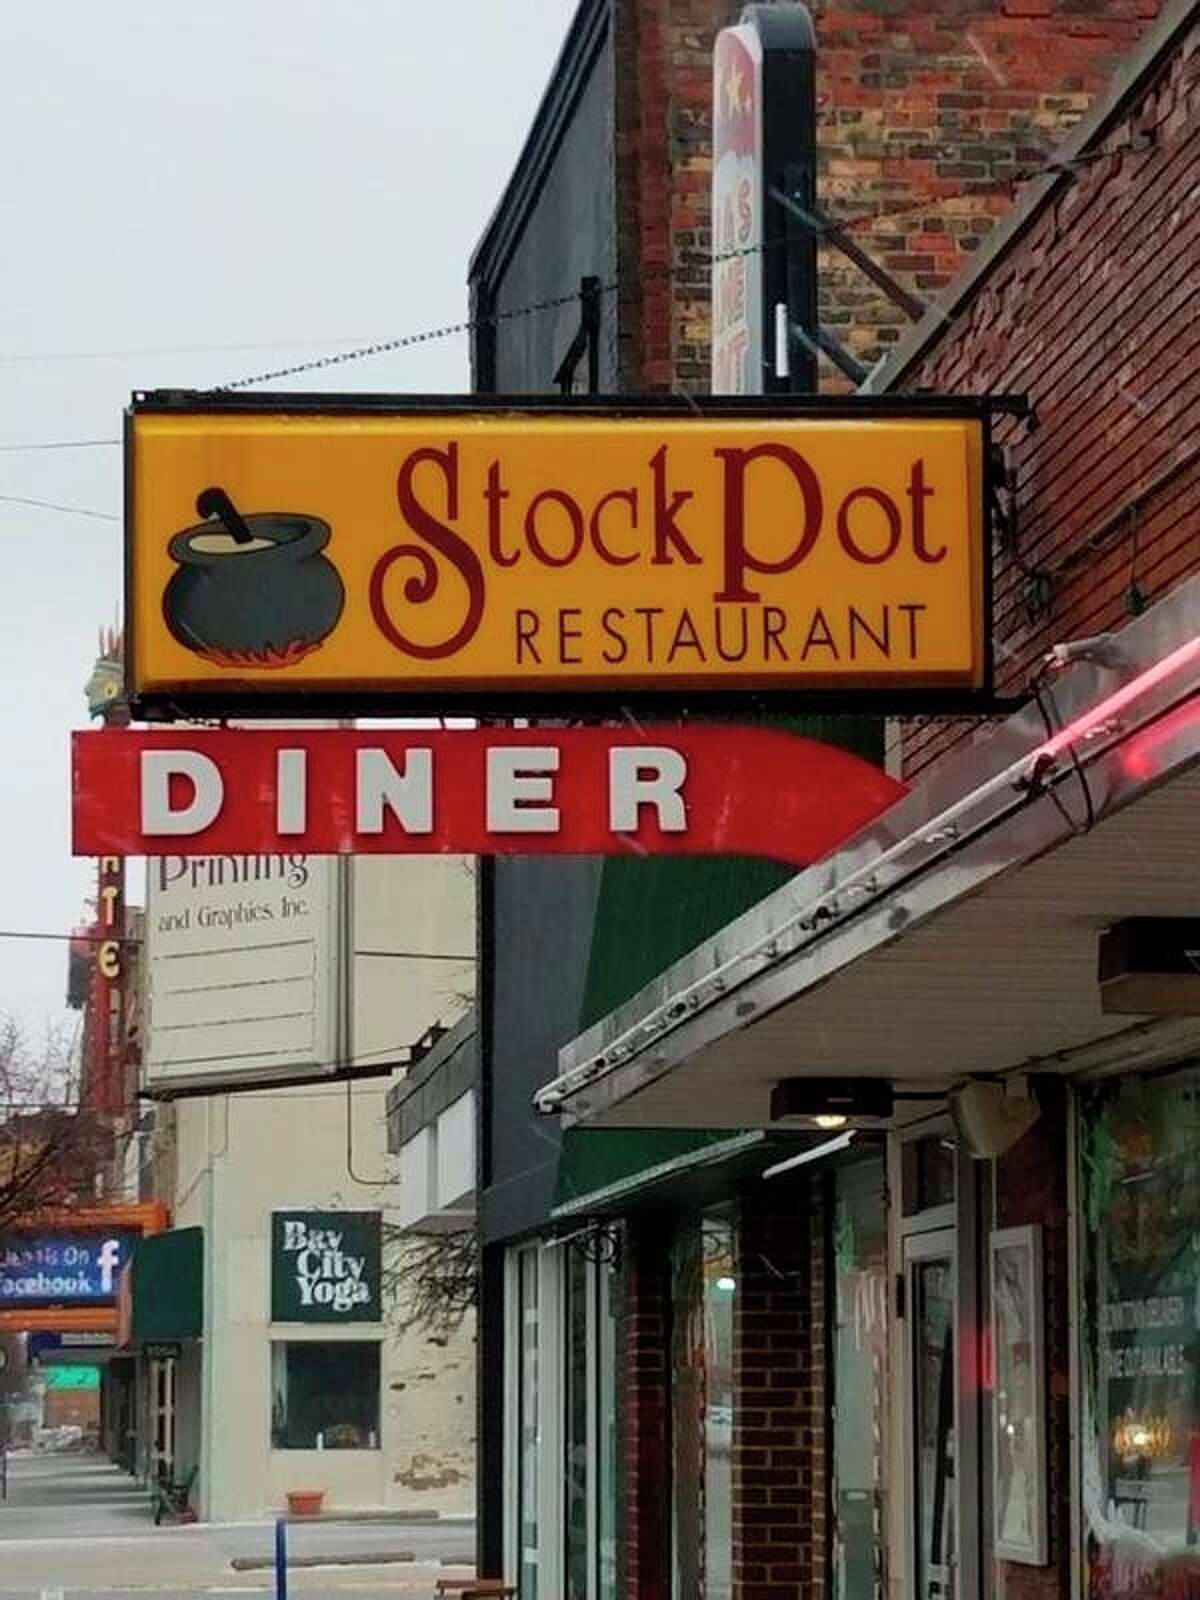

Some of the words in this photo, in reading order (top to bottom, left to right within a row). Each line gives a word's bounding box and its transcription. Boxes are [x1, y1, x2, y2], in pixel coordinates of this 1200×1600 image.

[515, 604, 927, 664] RESTAURANT
[140, 746, 689, 836] DINER
[159, 909, 190, 932] and
[283, 1221, 343, 1253] Bay
[63, 1246, 90, 1265] On
[297, 1248, 365, 1282] City
[0, 1271, 93, 1296] acebook
[296, 1276, 370, 1312] Yoga
